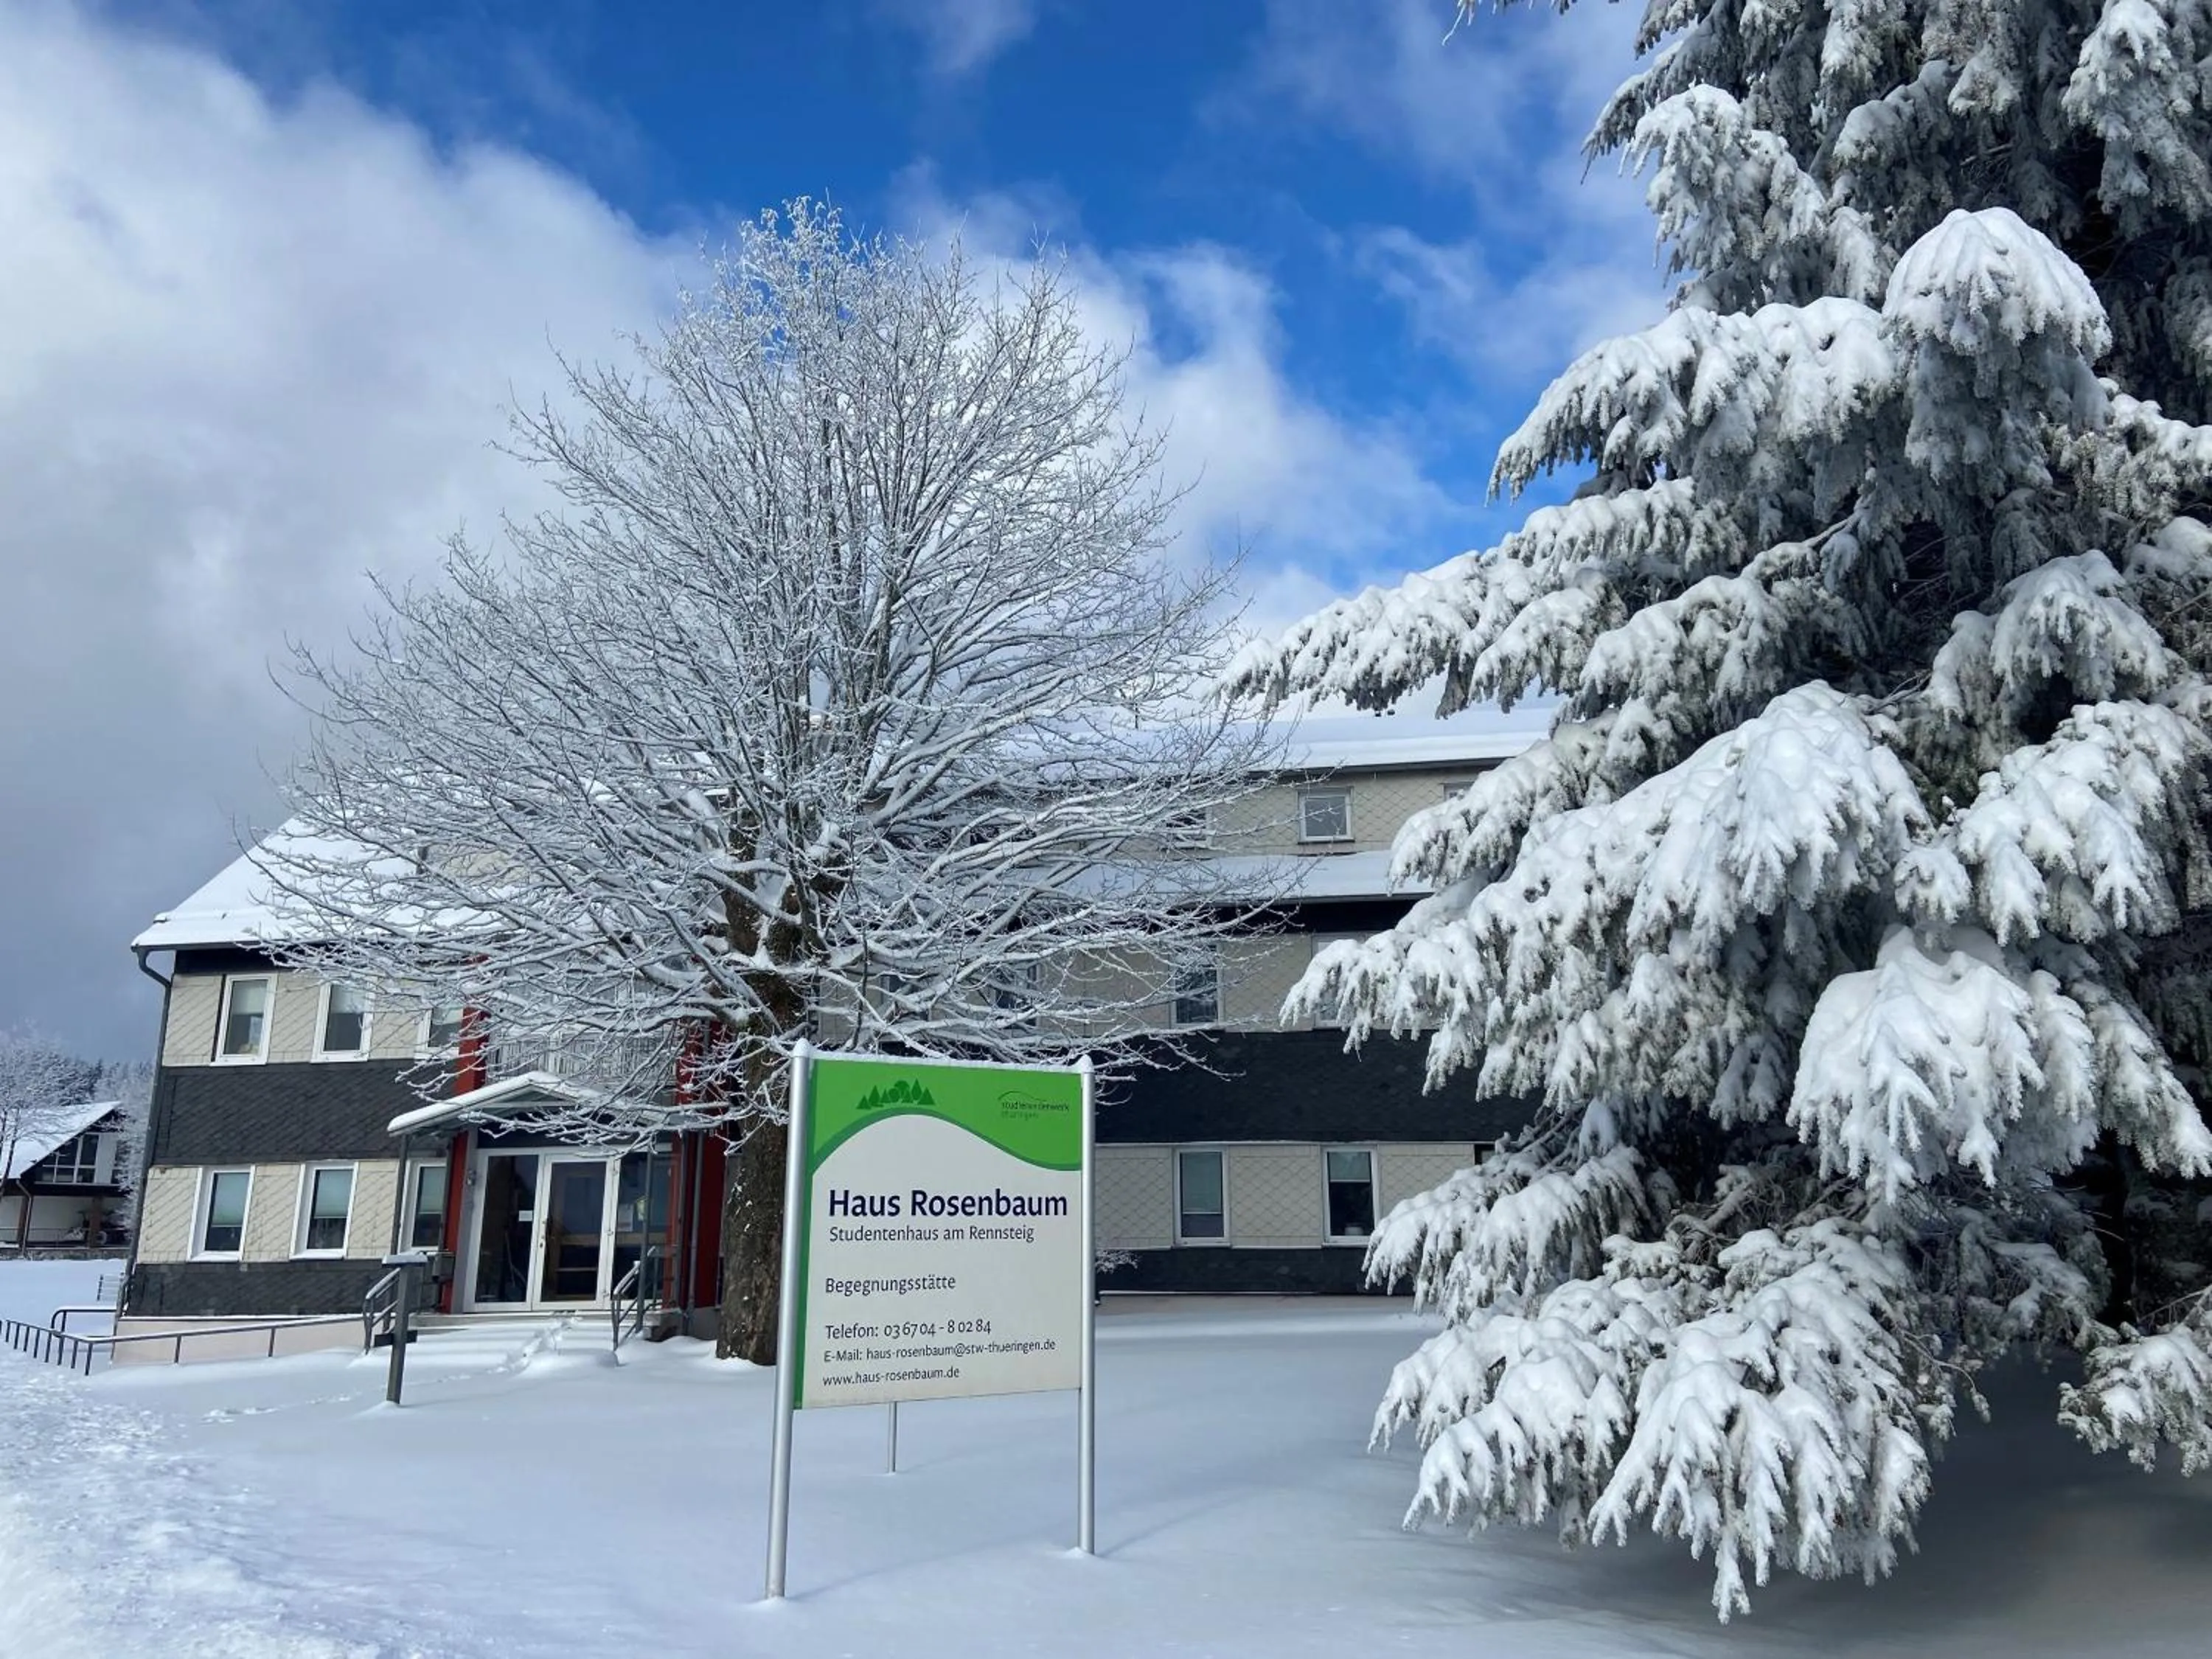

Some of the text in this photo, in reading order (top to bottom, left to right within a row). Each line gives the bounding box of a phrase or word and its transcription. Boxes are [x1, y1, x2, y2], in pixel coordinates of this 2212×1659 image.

[829, 1188, 1068, 1217] Haus Rosenbaum
[829, 1225, 1034, 1243] Studentenhaus am Rennsteig
[825, 1274, 956, 1296] Begegnungsstätte
[825, 1323, 879, 1339] Telefon:
[824, 1338, 1056, 1362] E-Mail: haus-rosenbaum@stw-thueringen.de
[822, 1367, 960, 1386] www.haus-rosenbaum.de
